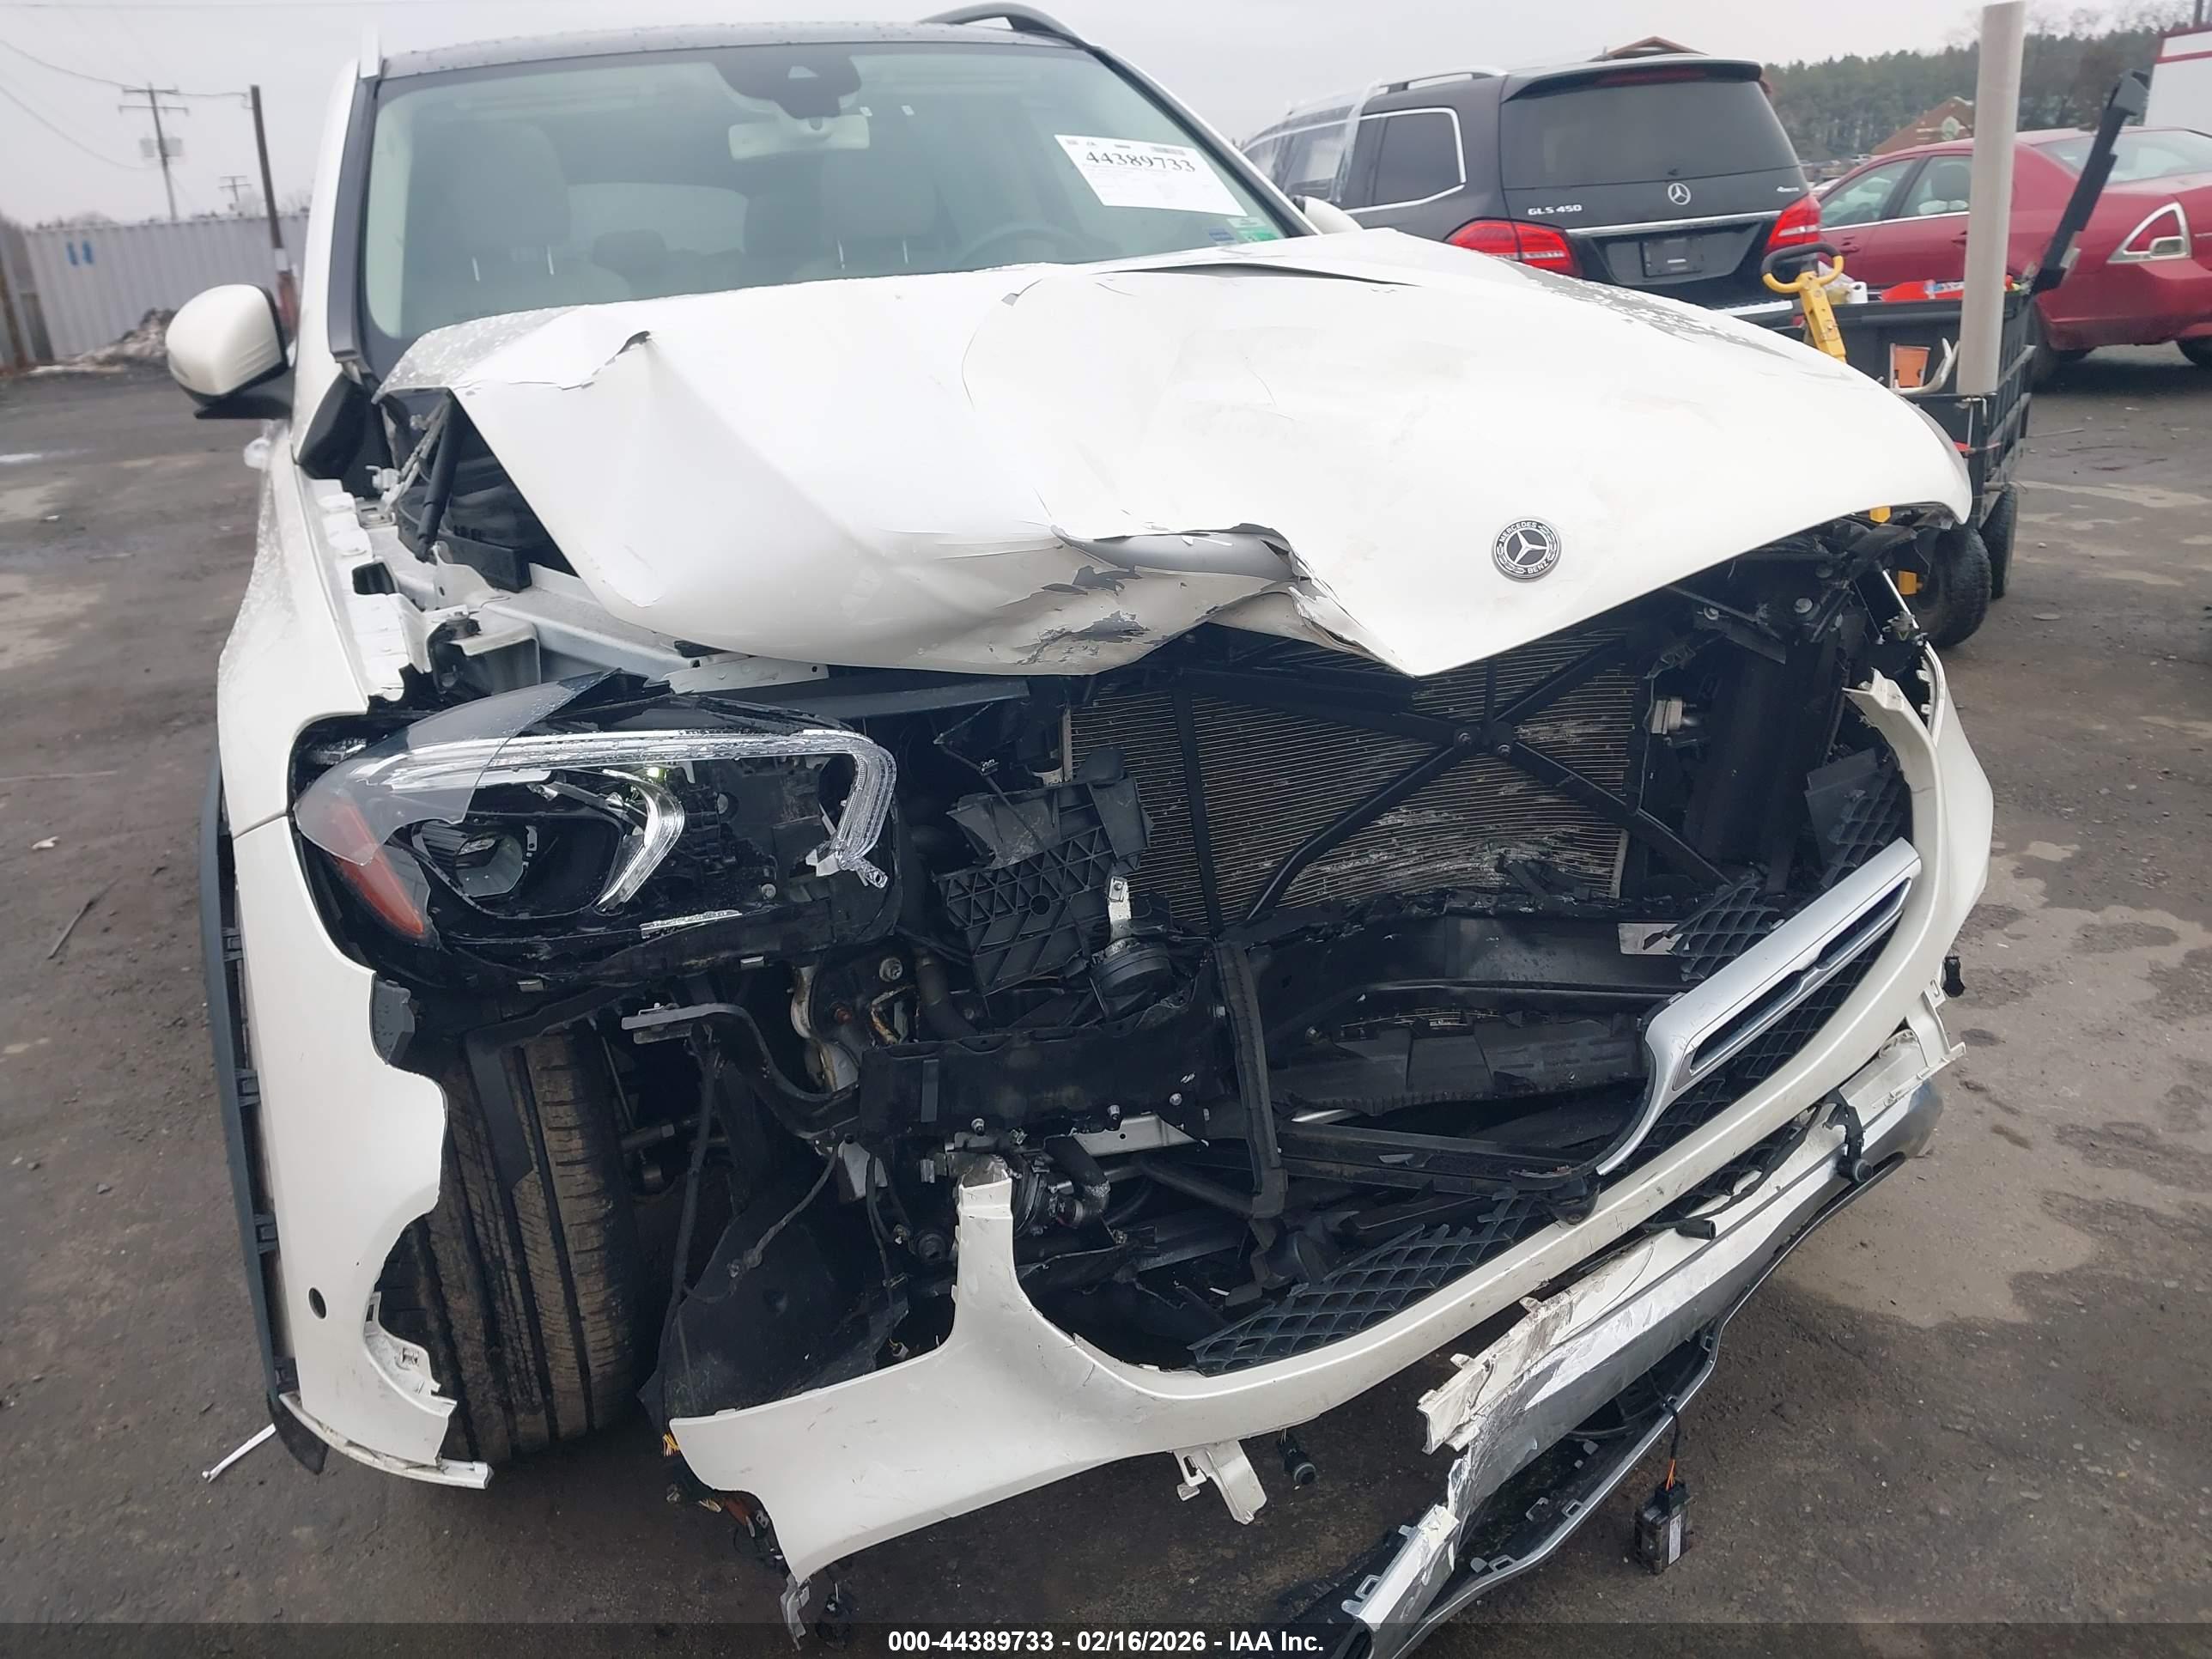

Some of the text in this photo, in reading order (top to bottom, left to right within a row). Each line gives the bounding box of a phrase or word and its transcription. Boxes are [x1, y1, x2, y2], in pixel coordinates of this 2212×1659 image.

[1085, 151, 1196, 173] 44389733
[1528, 204, 1583, 216] GLS 450
[1498, 521, 1538, 543] MERCEDES
[1527, 561, 1549, 574] BENZ
